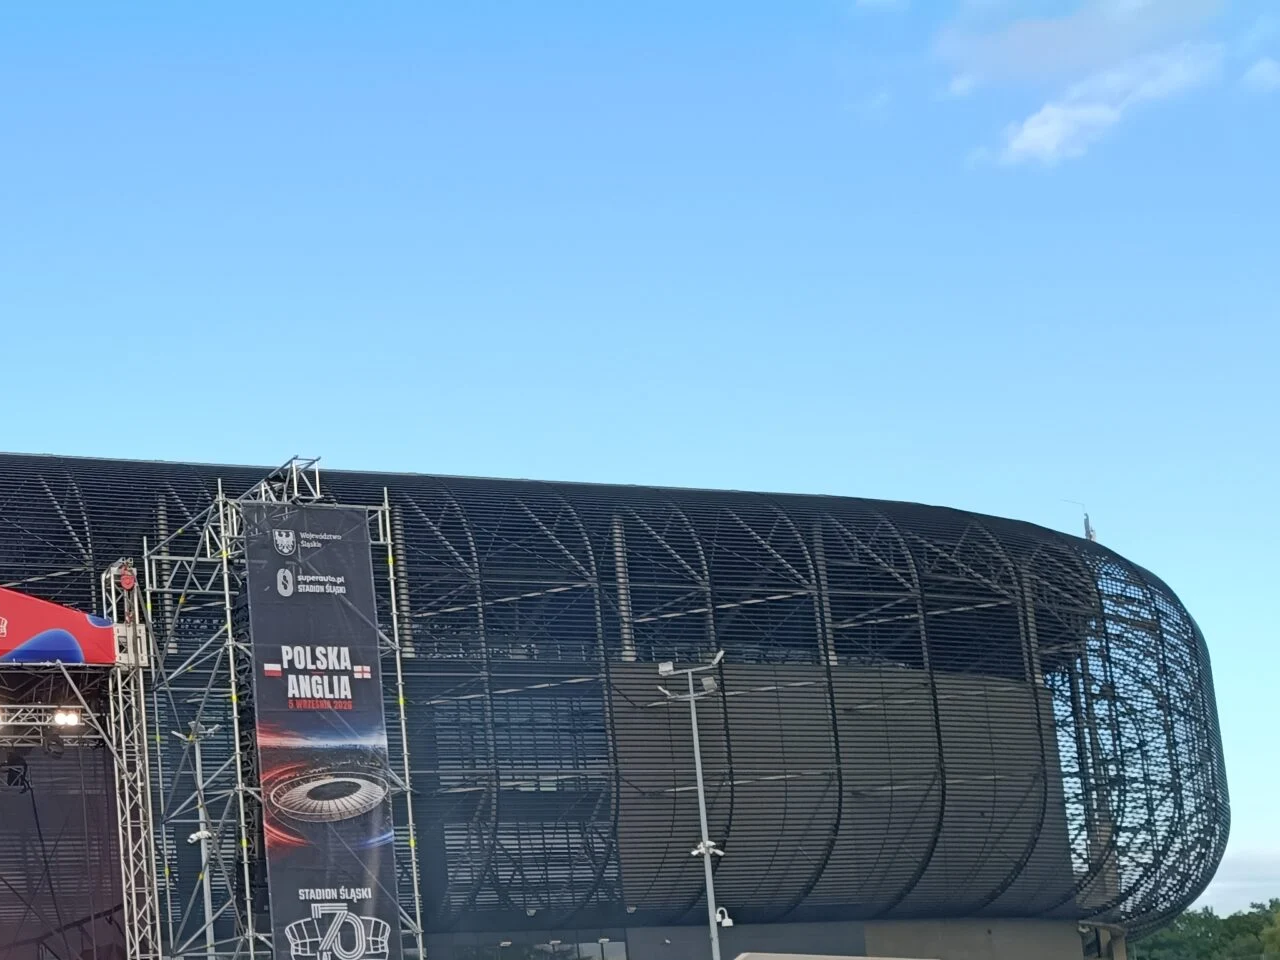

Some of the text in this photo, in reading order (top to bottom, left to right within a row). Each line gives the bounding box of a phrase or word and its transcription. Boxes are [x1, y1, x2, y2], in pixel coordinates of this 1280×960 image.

[297, 574, 345, 583] superauto.pl
[297, 585, 325, 593] STADION
[281, 645, 351, 670] POLSKA
[287, 674, 352, 699] ANGLIA
[298, 885, 371, 903] STADION ŚLĄSKI
